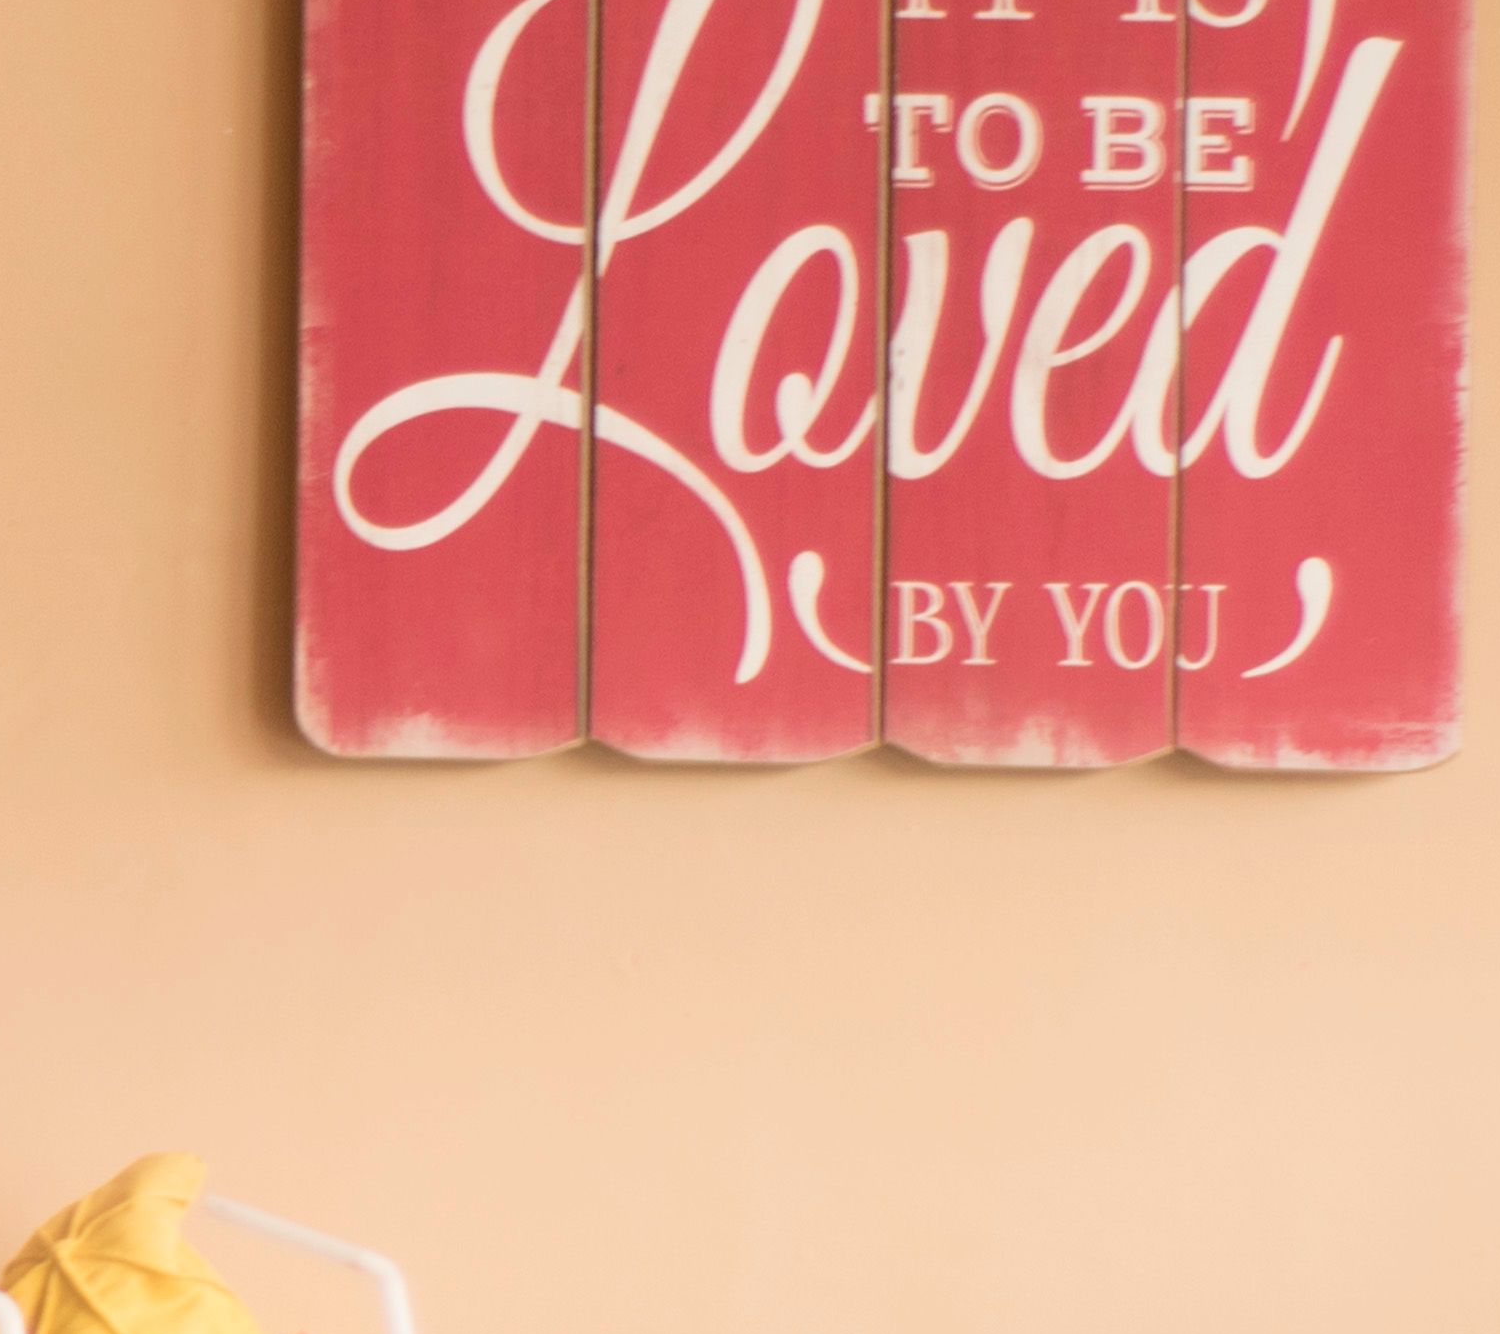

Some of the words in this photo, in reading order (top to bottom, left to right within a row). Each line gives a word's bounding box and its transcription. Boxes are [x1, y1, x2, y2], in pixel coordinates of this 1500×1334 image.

[864, 91, 1043, 193] TO
[1080, 91, 1256, 193] BE
[890, 578, 1012, 670] BY
[1043, 578, 1226, 670] YOU
